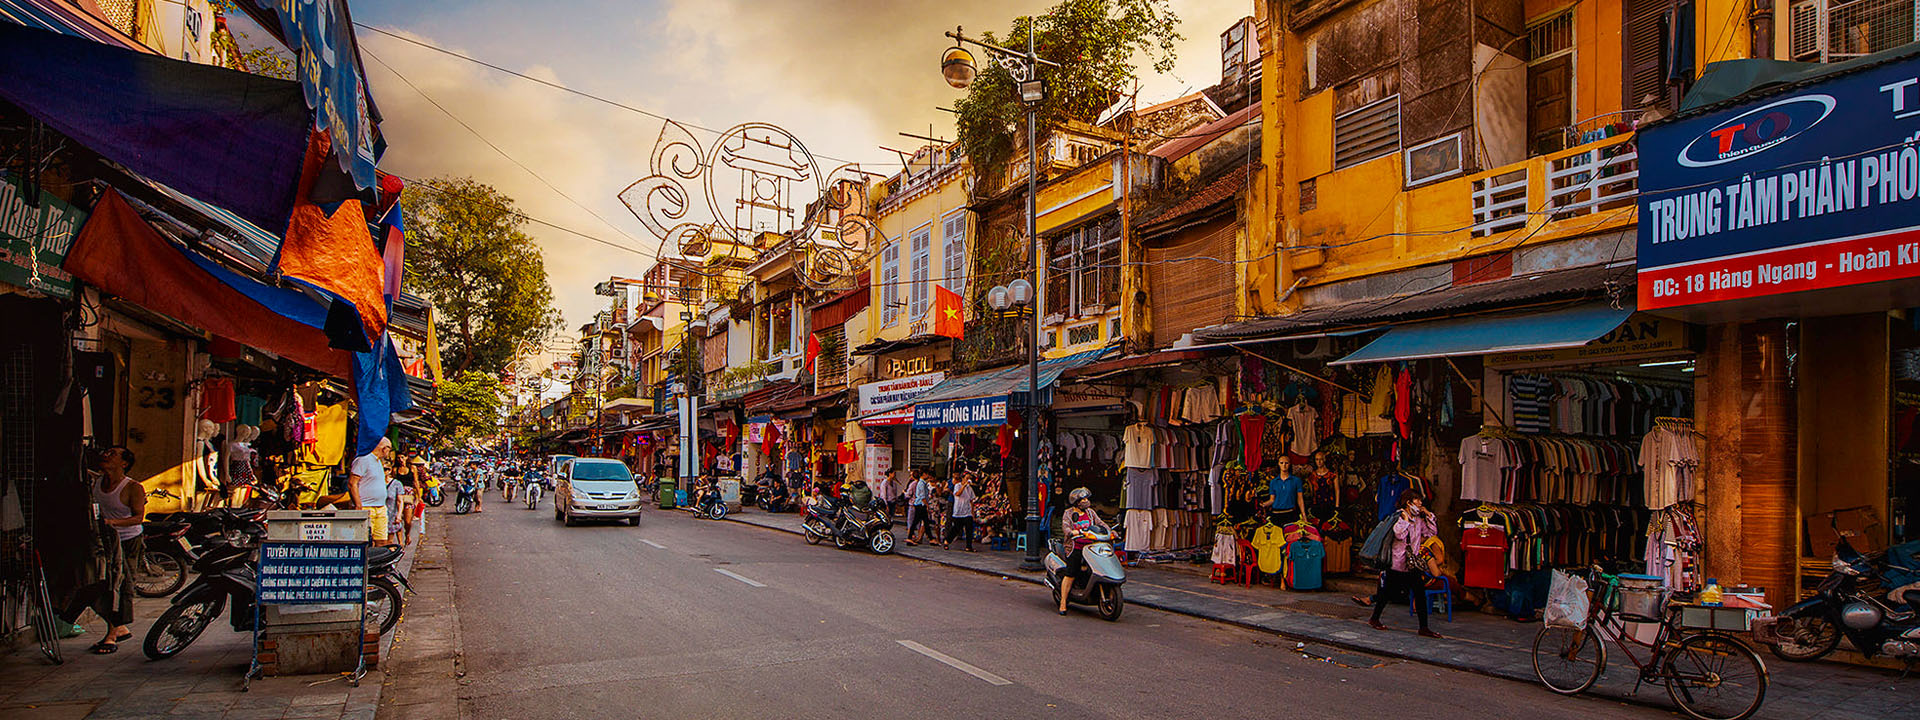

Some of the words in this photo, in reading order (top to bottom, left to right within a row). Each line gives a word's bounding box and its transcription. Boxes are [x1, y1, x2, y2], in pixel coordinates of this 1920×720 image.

[1649, 187, 1722, 245] TRUNG
[1726, 172, 1778, 231] TÂM
[1782, 155, 1855, 221] PHÂN
[1860, 130, 1920, 208] PHỐ
[1653, 278, 1680, 298] ĐC:
[1685, 273, 1704, 293] 18
[1709, 267, 1752, 291] Hàng
[1758, 259, 1817, 286] Ngang
[1839, 248, 1891, 273] Hoàn
[1897, 242, 1920, 266] Ki
[139, 386, 176, 410] 23
[972, 399, 990, 421] HẢI
[319, 547, 338, 558] MINH
